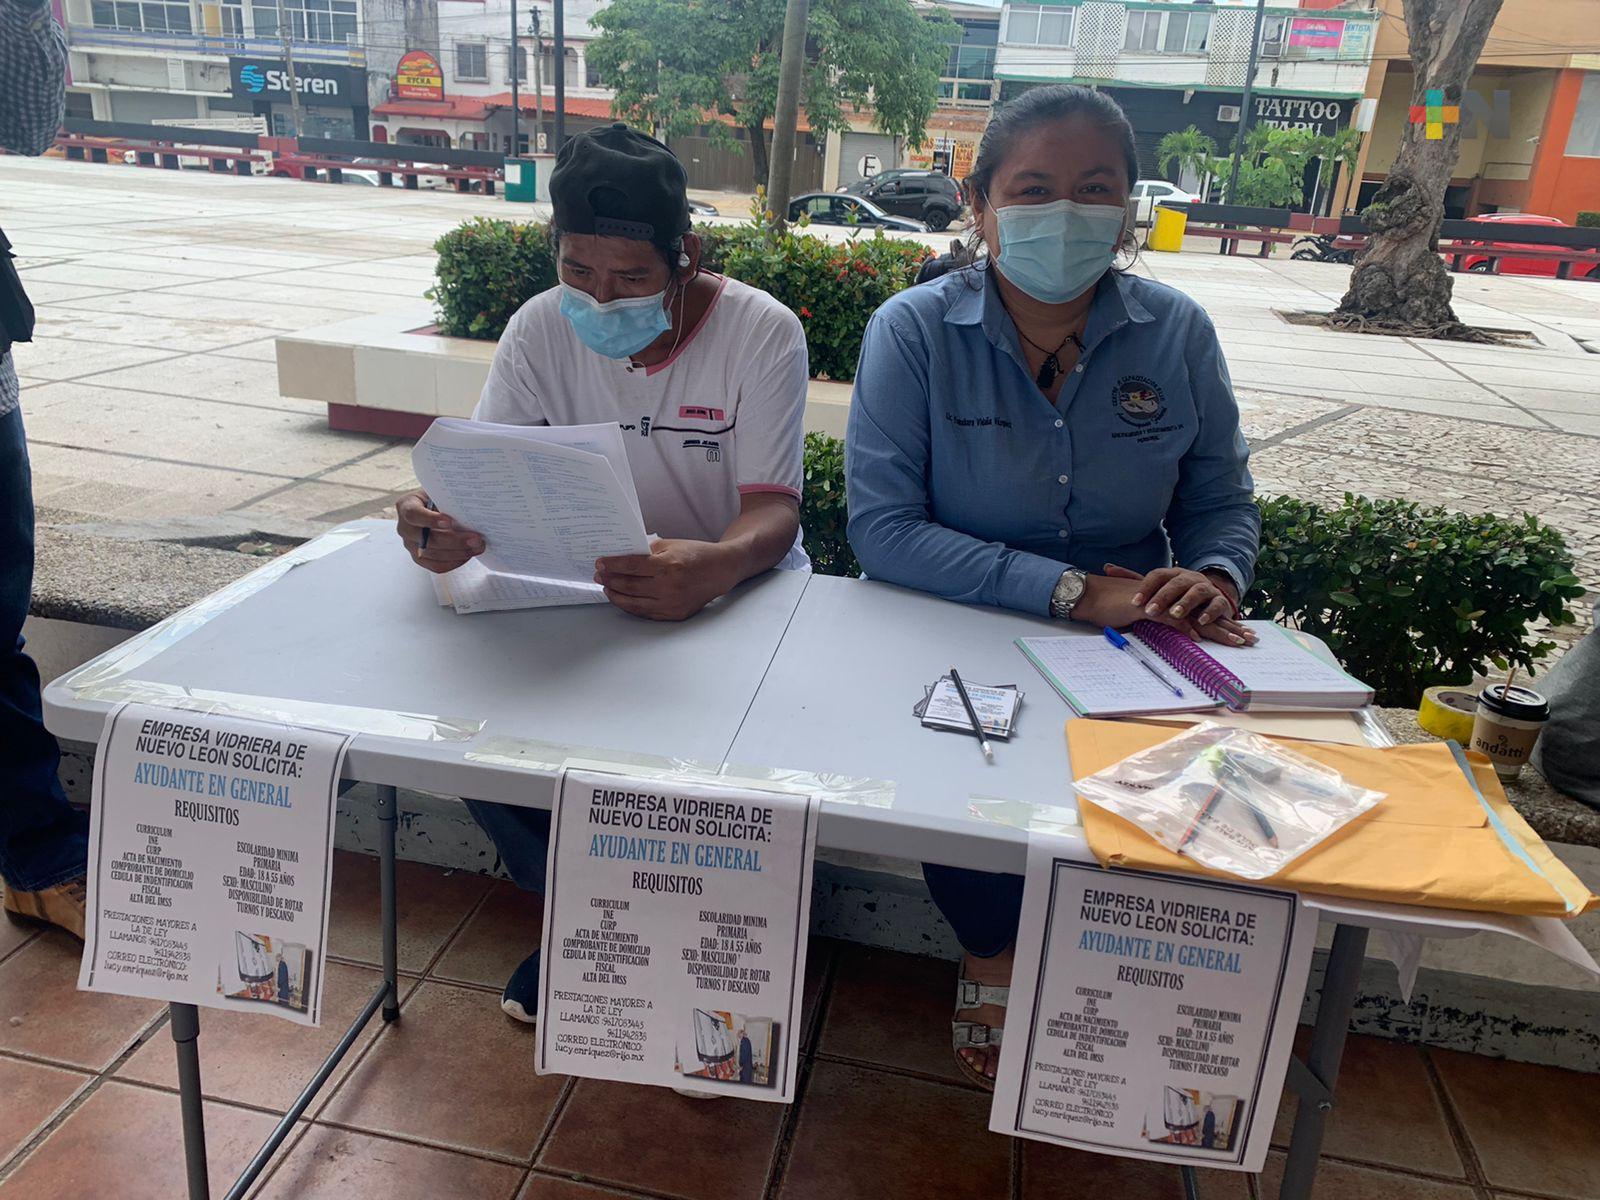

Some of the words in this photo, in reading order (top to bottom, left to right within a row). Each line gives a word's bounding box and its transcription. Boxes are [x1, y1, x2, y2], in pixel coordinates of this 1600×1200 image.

[266, 70, 338, 95] Steren
[1255, 98, 1341, 120] TATTOO
[864, 156, 877, 178] E
[141, 719, 210, 744] EMPRESA
[216, 731, 281, 756] VIDRIERA
[285, 743, 308, 760] DE
[1476, 737, 1524, 758] andatti
[136, 736, 185, 758] NUEVO
[189, 745, 229, 766] LEON
[232, 752, 302, 778] SOLICITA:
[134, 762, 204, 793] AYUDANTE
[208, 774, 226, 797] EN
[230, 777, 292, 808] GENERAL
[175, 799, 239, 826] REQUISITOS
[592, 789, 667, 813] EMPRESA
[673, 798, 746, 822] VIDRIERA
[751, 807, 773, 825] DE
[136, 823, 172, 837] CURRICULUM
[589, 807, 643, 828] NUEVO
[648, 814, 691, 833] LEON
[695, 819, 771, 842] SOLICITA:
[148, 835, 159, 845] INE
[146, 845, 162, 855] CURP
[237, 841, 275, 858] ESCOLARIDAD
[276, 849, 299, 863] MINIMA
[589, 834, 666, 863] AYUDANTE
[670, 842, 690, 865] EN
[695, 844, 761, 872] GENERAL
[111, 860, 154, 876] COMPROBANTE
[155, 866, 163, 876] DE
[164, 867, 194, 880] DOMICILIO
[122, 852, 136, 862] ACTA
[137, 854, 146, 864] DE
[147, 855, 182, 870] NACIMIENTO
[253, 856, 281, 872] PRIMARIA
[111, 870, 133, 882] CEDULA
[134, 873, 142, 883] DE
[143, 875, 193, 890] INDENTIFICACION
[222, 875, 239, 888] SEXO:
[239, 866, 256, 881] EDAD:
[258, 869, 265, 881] 18
[264, 871, 272, 882] A
[271, 872, 278, 883] 55
[279, 872, 295, 886] AÑOS
[632, 871, 702, 895] REQUISITOS
[130, 893, 143, 903] ALTA
[145, 895, 156, 905] DEL
[157, 897, 172, 907] IMSS
[141, 885, 162, 896] FISCAL
[228, 888, 274, 907] DISPONIBILIDAD
[275, 897, 283, 908] DE
[284, 898, 303, 912] ROTAR
[236, 901, 259, 916] TURNOS
[260, 906, 266, 917] Y
[265, 907, 294, 922] DESCANSO
[590, 898, 630, 911] CURRICULUM
[603, 909, 614, 919] INE
[1083, 889, 1155, 913] EMPRESA
[1161, 900, 1230, 925] VIDRIERA
[1235, 912, 1256, 929] DE
[103, 909, 154, 925] PRESTACIONES
[155, 919, 190, 930] MAYORES
[191, 923, 197, 931] A
[600, 920, 617, 931] CURP
[699, 910, 742, 925] ESCOLARIDAD
[743, 915, 767, 928] MINIMA
[1080, 905, 1131, 927] NUEVO
[1136, 914, 1177, 934] LEON
[1181, 921, 1254, 946] SOLICITA:
[131, 924, 141, 933] LA
[142, 925, 155, 935] DE
[154, 927, 168, 938] LEY
[575, 928, 592, 939] ACTA
[591, 930, 601, 940] DE
[601, 931, 638, 944] NACIMIENTO
[716, 925, 747, 939] PRIMARIA
[563, 938, 608, 953] COMPROBANTE
[609, 942, 618, 953] DE
[619, 943, 651, 956] DOMICILIO
[681, 948, 699, 961] SEXO:
[700, 937, 719, 950] EDAD:
[721, 939, 730, 951] 18
[729, 940, 734, 951] A
[735, 940, 744, 953] 55
[745, 938, 762, 954] AÑOS
[1079, 930, 1152, 960] AYUDANTE
[1155, 941, 1175, 962] EN
[1178, 945, 1241, 974] GENERAL
[107, 950, 137, 963] CORREO
[562, 949, 586, 960] CEDULA
[588, 951, 596, 961] DE
[597, 952, 649, 966] INDENTIFICACION
[595, 962, 616, 975] FISCAL
[687, 962, 739, 979] DISPONIBILIDAD
[739, 968, 749, 980] DE
[749, 969, 770, 982] ROTAR
[1117, 965, 1184, 990] REQUISITOS
[582, 972, 597, 982] ALTA
[598, 973, 610, 983] DEL
[612, 974, 627, 985] IMSS
[696, 976, 721, 991] TURNOS
[722, 979, 727, 991] Y
[727, 980, 760, 995] DESCANSO
[554, 990, 608, 1005] PRESTACIONES
[610, 998, 646, 1008] MAYORES
[647, 1001, 653, 1009] A
[583, 1004, 593, 1013] LA
[596, 1005, 606, 1015] DE
[608, 1007, 623, 1017] LEY
[556, 1034, 589, 1045] CORREO
